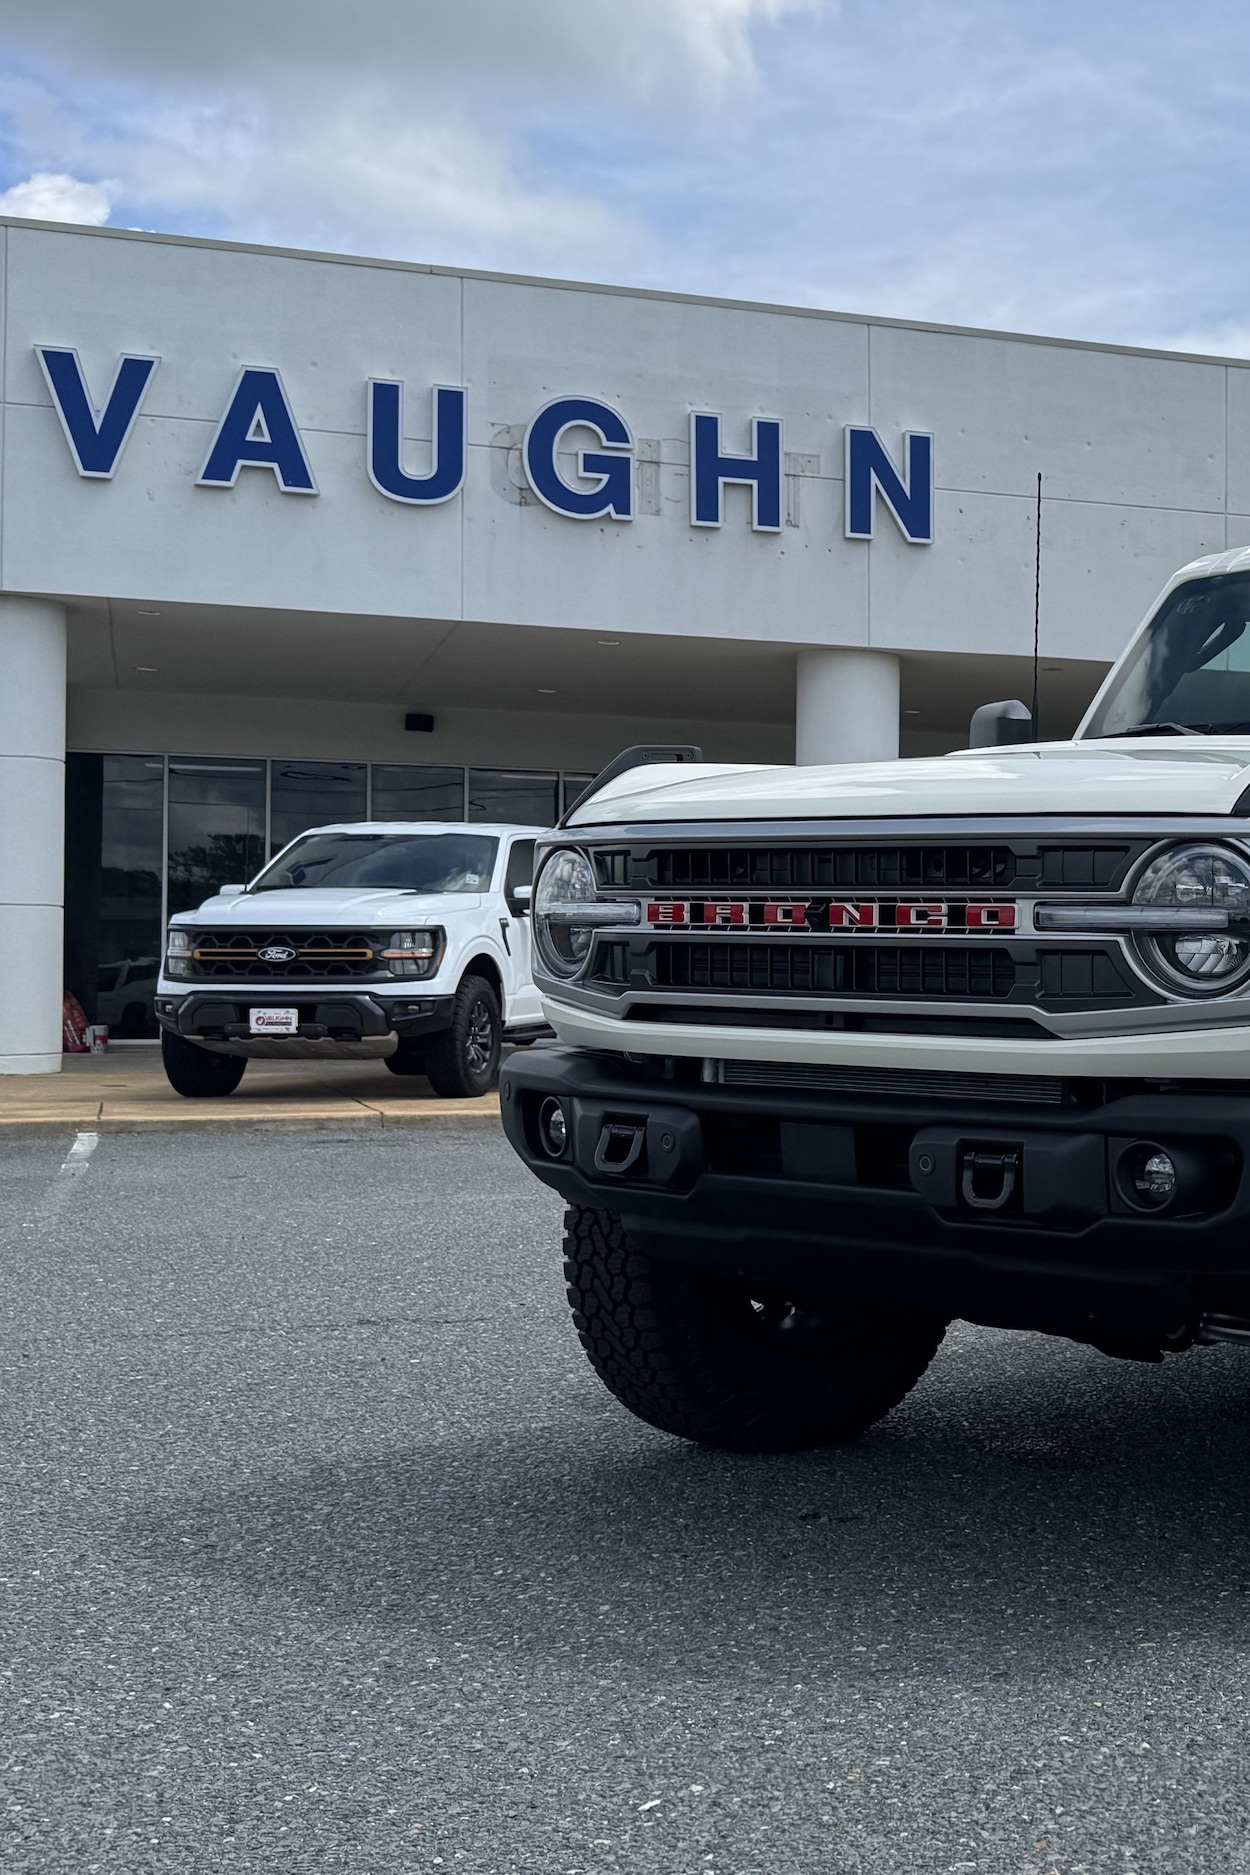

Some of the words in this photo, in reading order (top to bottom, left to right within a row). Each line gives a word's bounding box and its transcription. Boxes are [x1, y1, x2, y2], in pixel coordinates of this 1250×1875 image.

[34, 344, 936, 545] VAUGHN
[647, 902, 1020, 929] BRONCO
[265, 949, 289, 959] Ford
